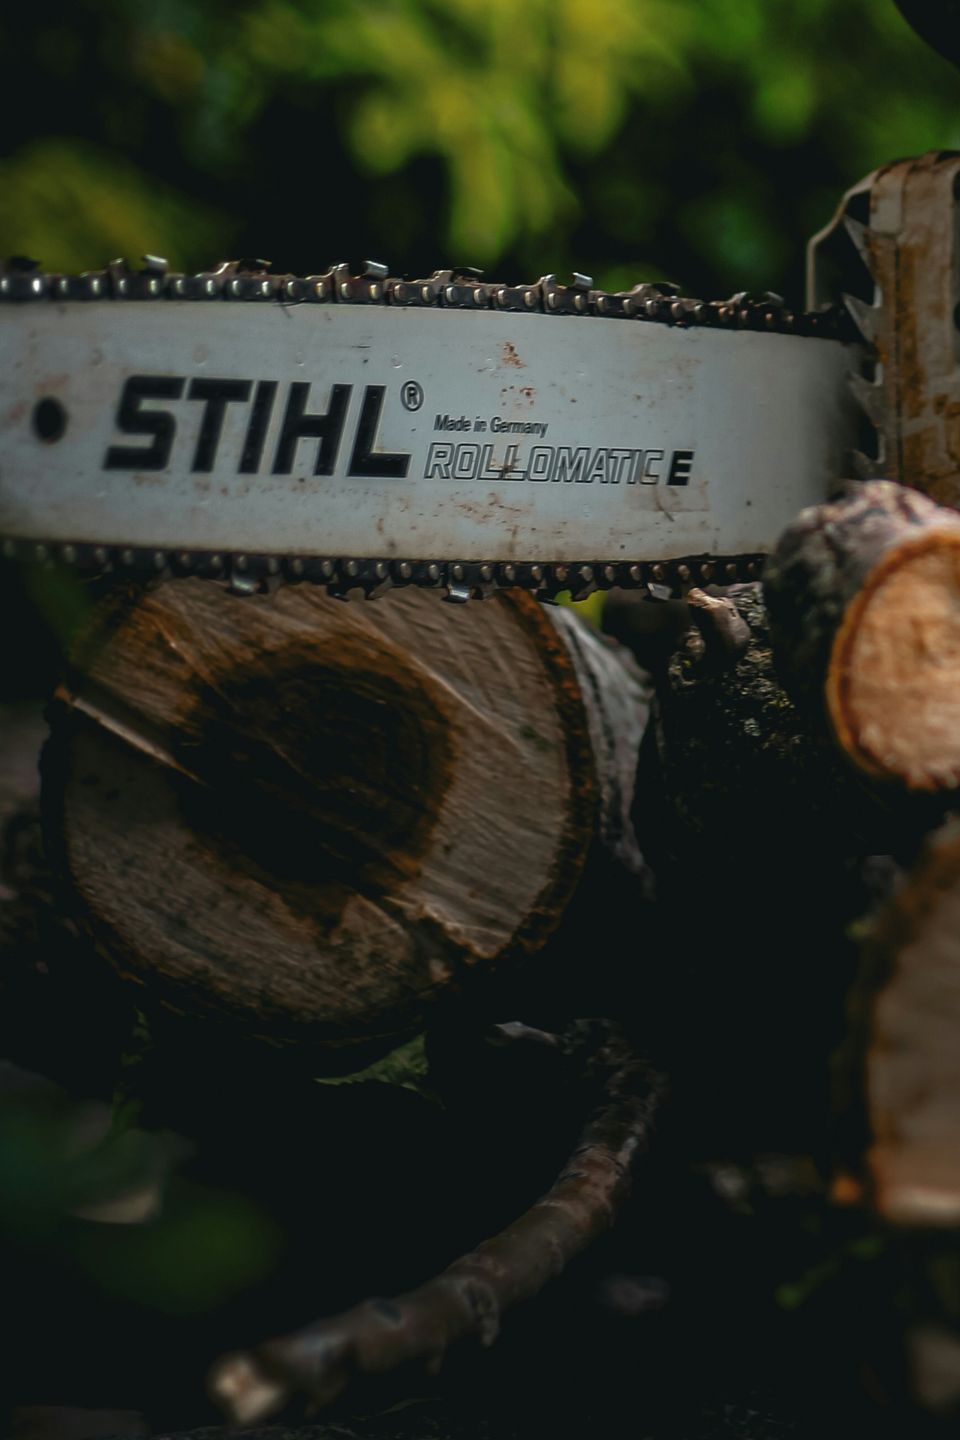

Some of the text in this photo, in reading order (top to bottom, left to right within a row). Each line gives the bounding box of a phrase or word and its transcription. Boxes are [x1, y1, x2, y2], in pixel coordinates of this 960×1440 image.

[433, 414, 549, 439] Made in Germany
[424, 442, 694, 487] ROLLOMATIC E
